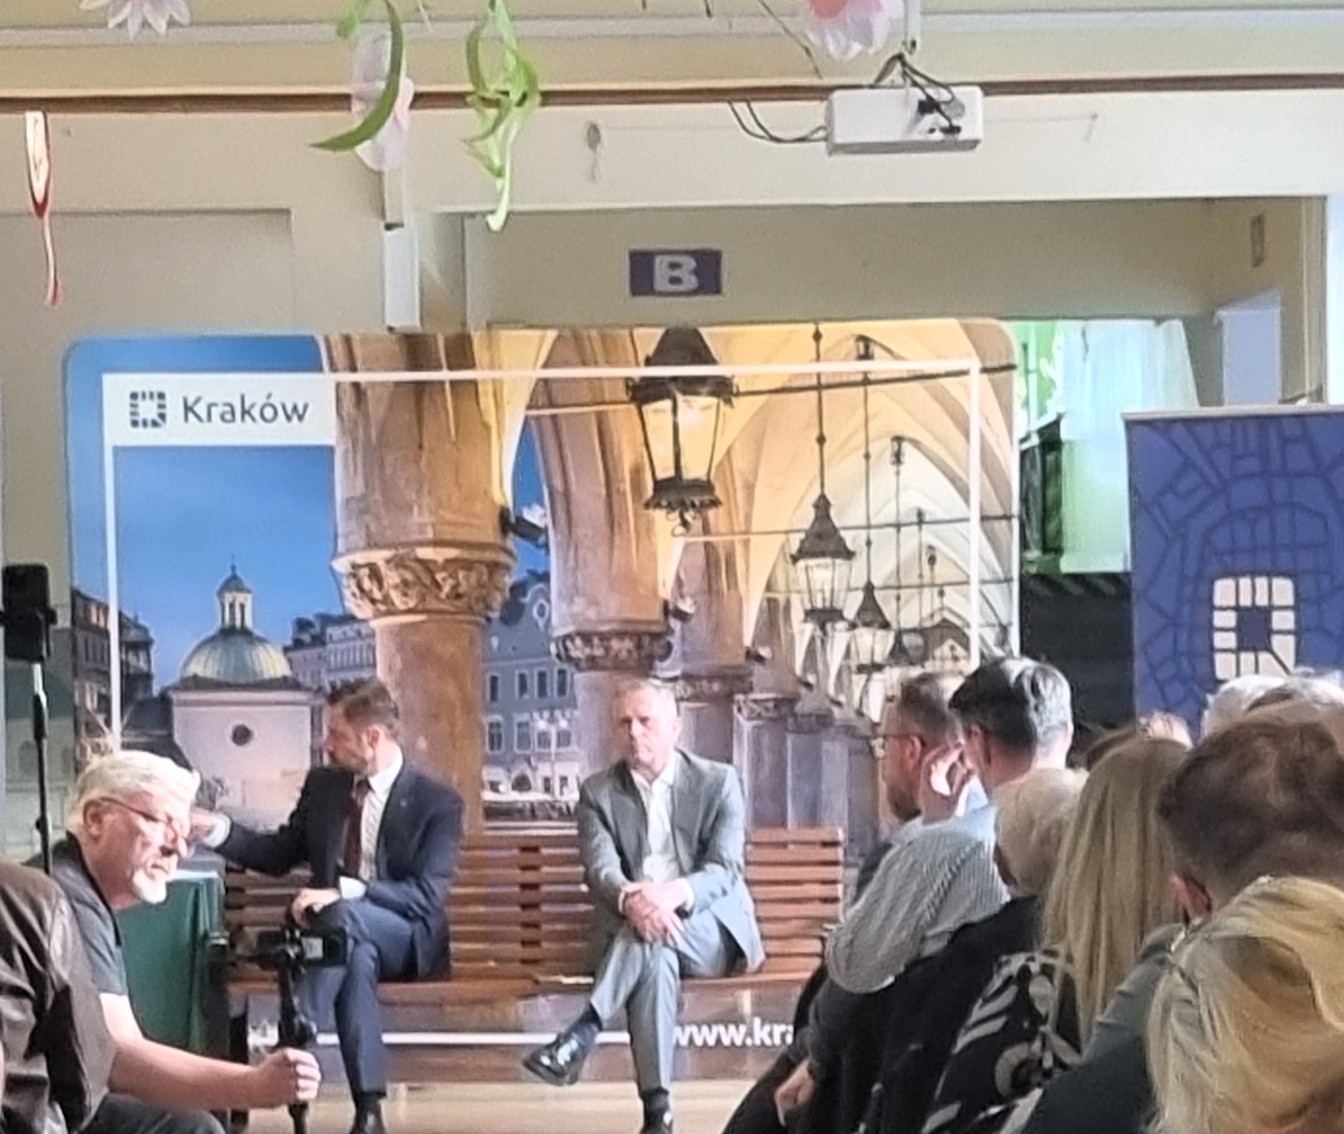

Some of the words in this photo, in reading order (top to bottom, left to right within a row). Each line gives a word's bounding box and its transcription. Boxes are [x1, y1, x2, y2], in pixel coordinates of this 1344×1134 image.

[654, 254, 699, 292] B
[182, 392, 310, 424] Kraków
[672, 1016, 794, 1047] www.kra
